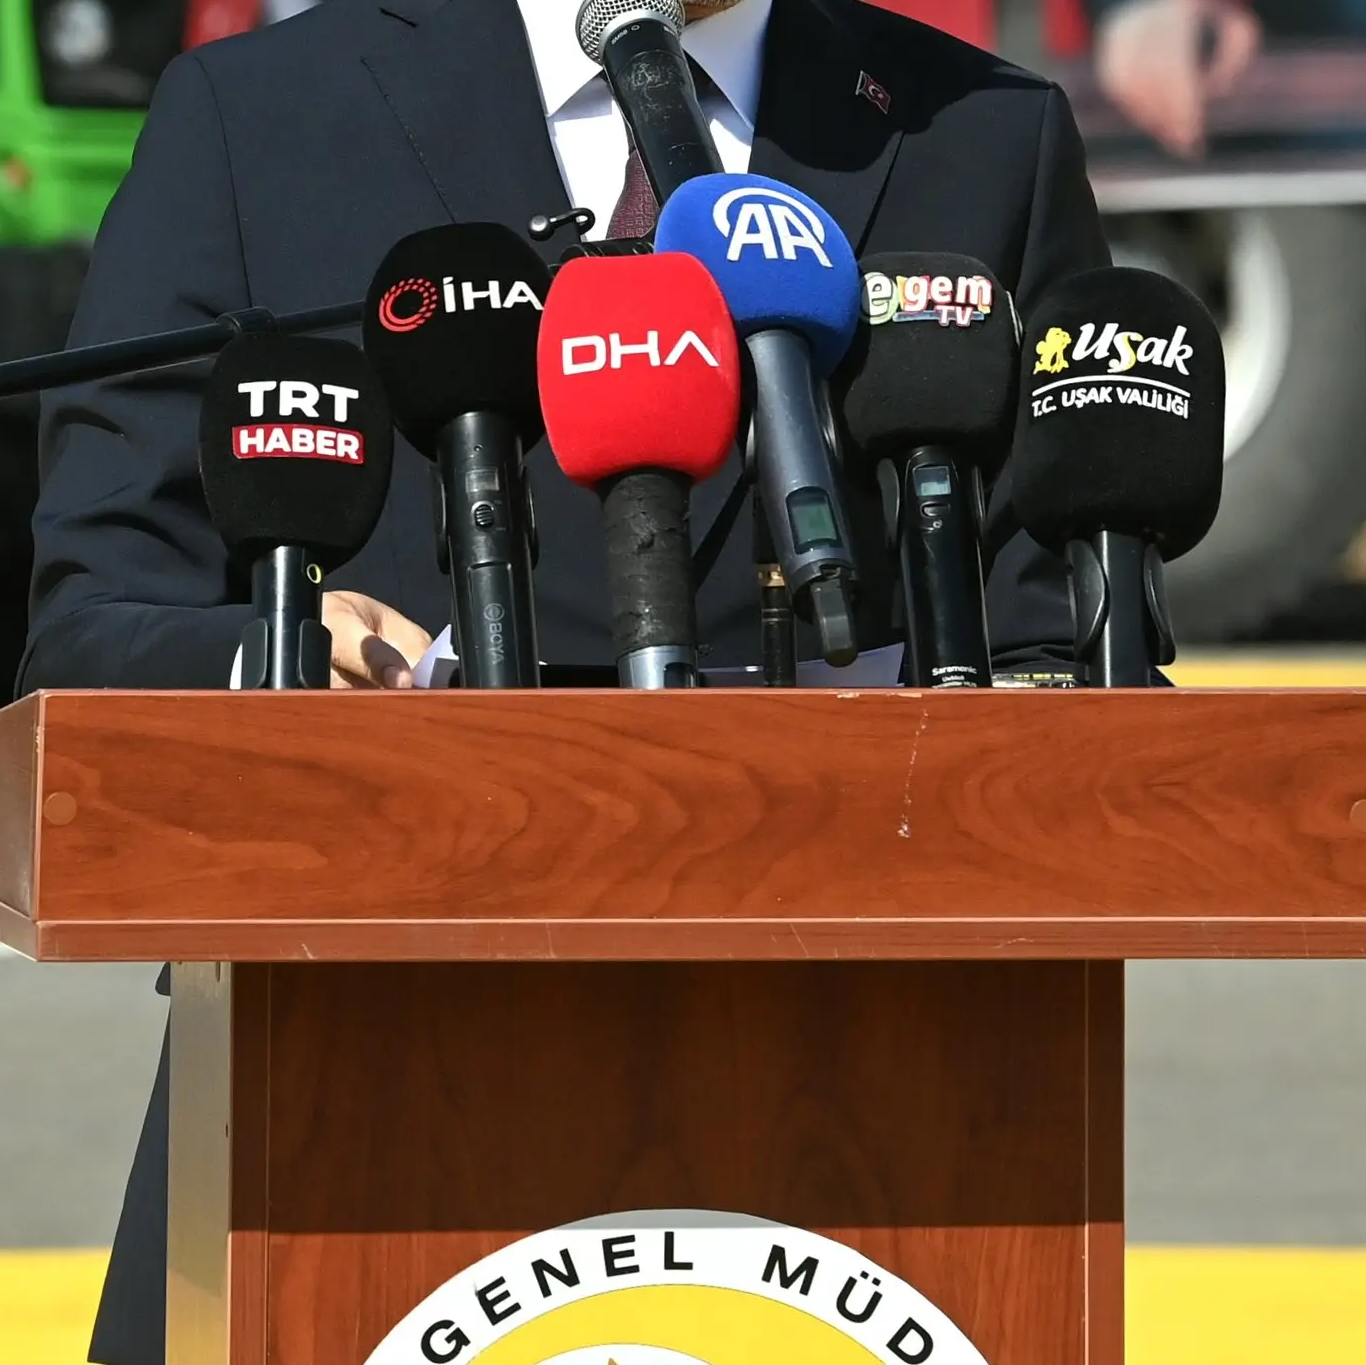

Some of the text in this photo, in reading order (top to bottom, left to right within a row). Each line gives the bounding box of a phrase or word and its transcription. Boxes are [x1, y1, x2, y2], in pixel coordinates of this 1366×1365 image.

[726, 202, 834, 268] AA
[442, 276, 544, 313] İHA
[936, 305, 974, 327] TV
[561, 330, 720, 376] DHA
[237, 380, 360, 423] TRT
[1061, 386, 1113, 409] UŞAK
[1116, 386, 1190, 419] VALİLİĞİ
[239, 427, 360, 460] HABER
[488, 622, 506, 665] BOYA
[420, 1231, 693, 1364] GENEL
